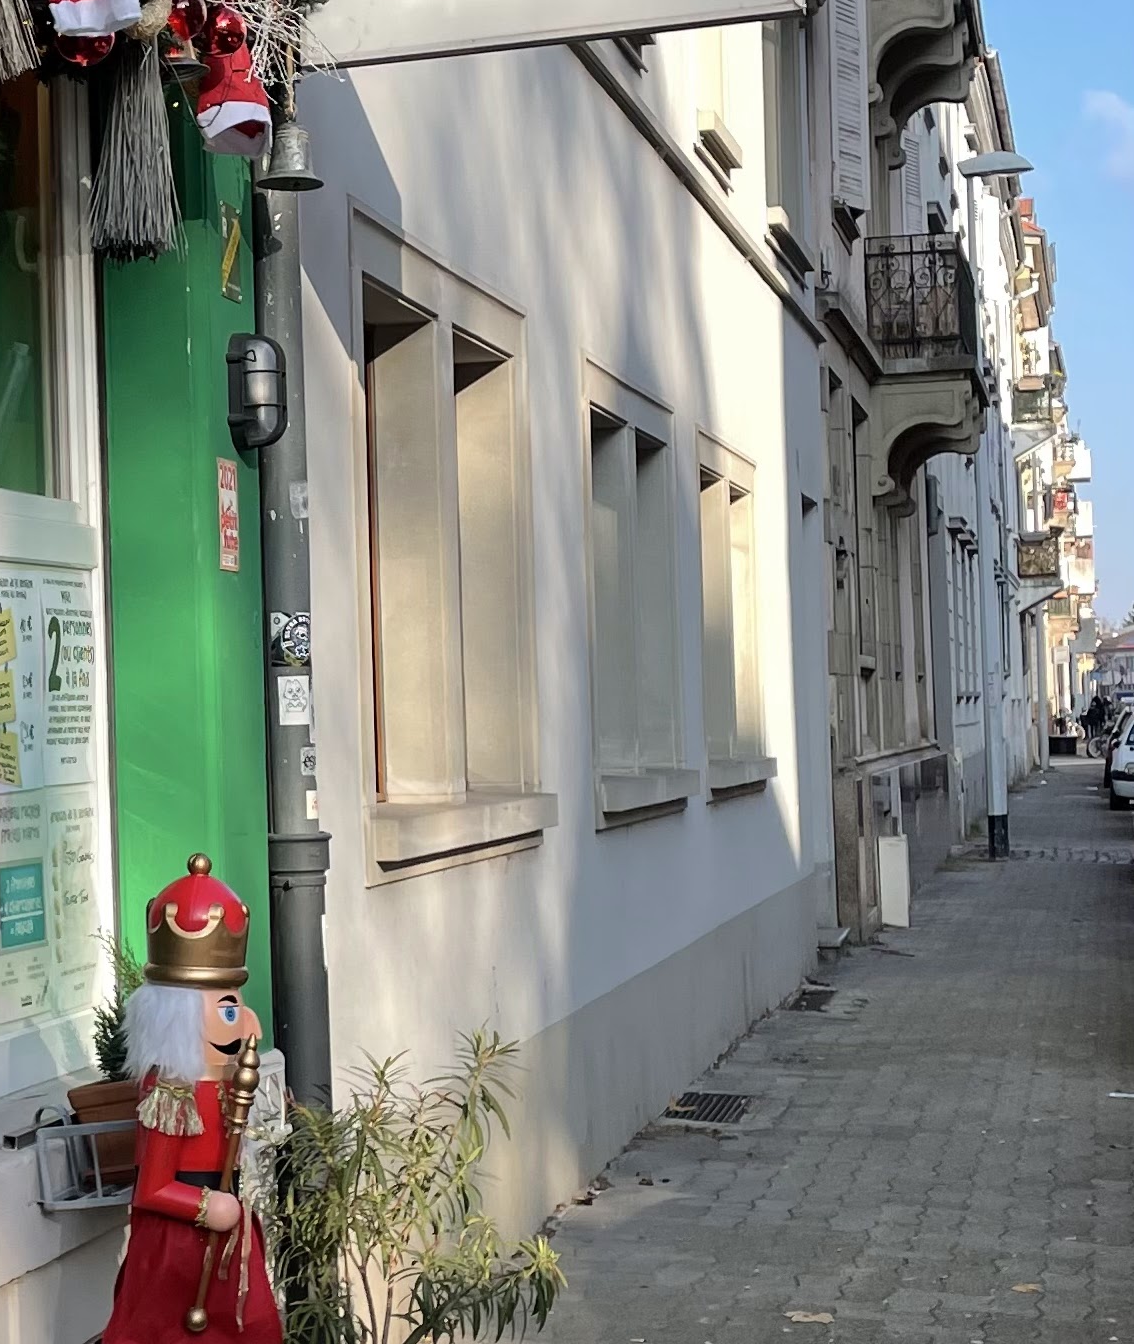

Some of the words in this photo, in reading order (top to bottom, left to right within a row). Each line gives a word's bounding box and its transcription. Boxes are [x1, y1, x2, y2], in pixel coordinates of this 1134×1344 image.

[219, 464, 236, 492] 2021
[48, 616, 62, 693] 2
[62, 619, 92, 637] personnes
